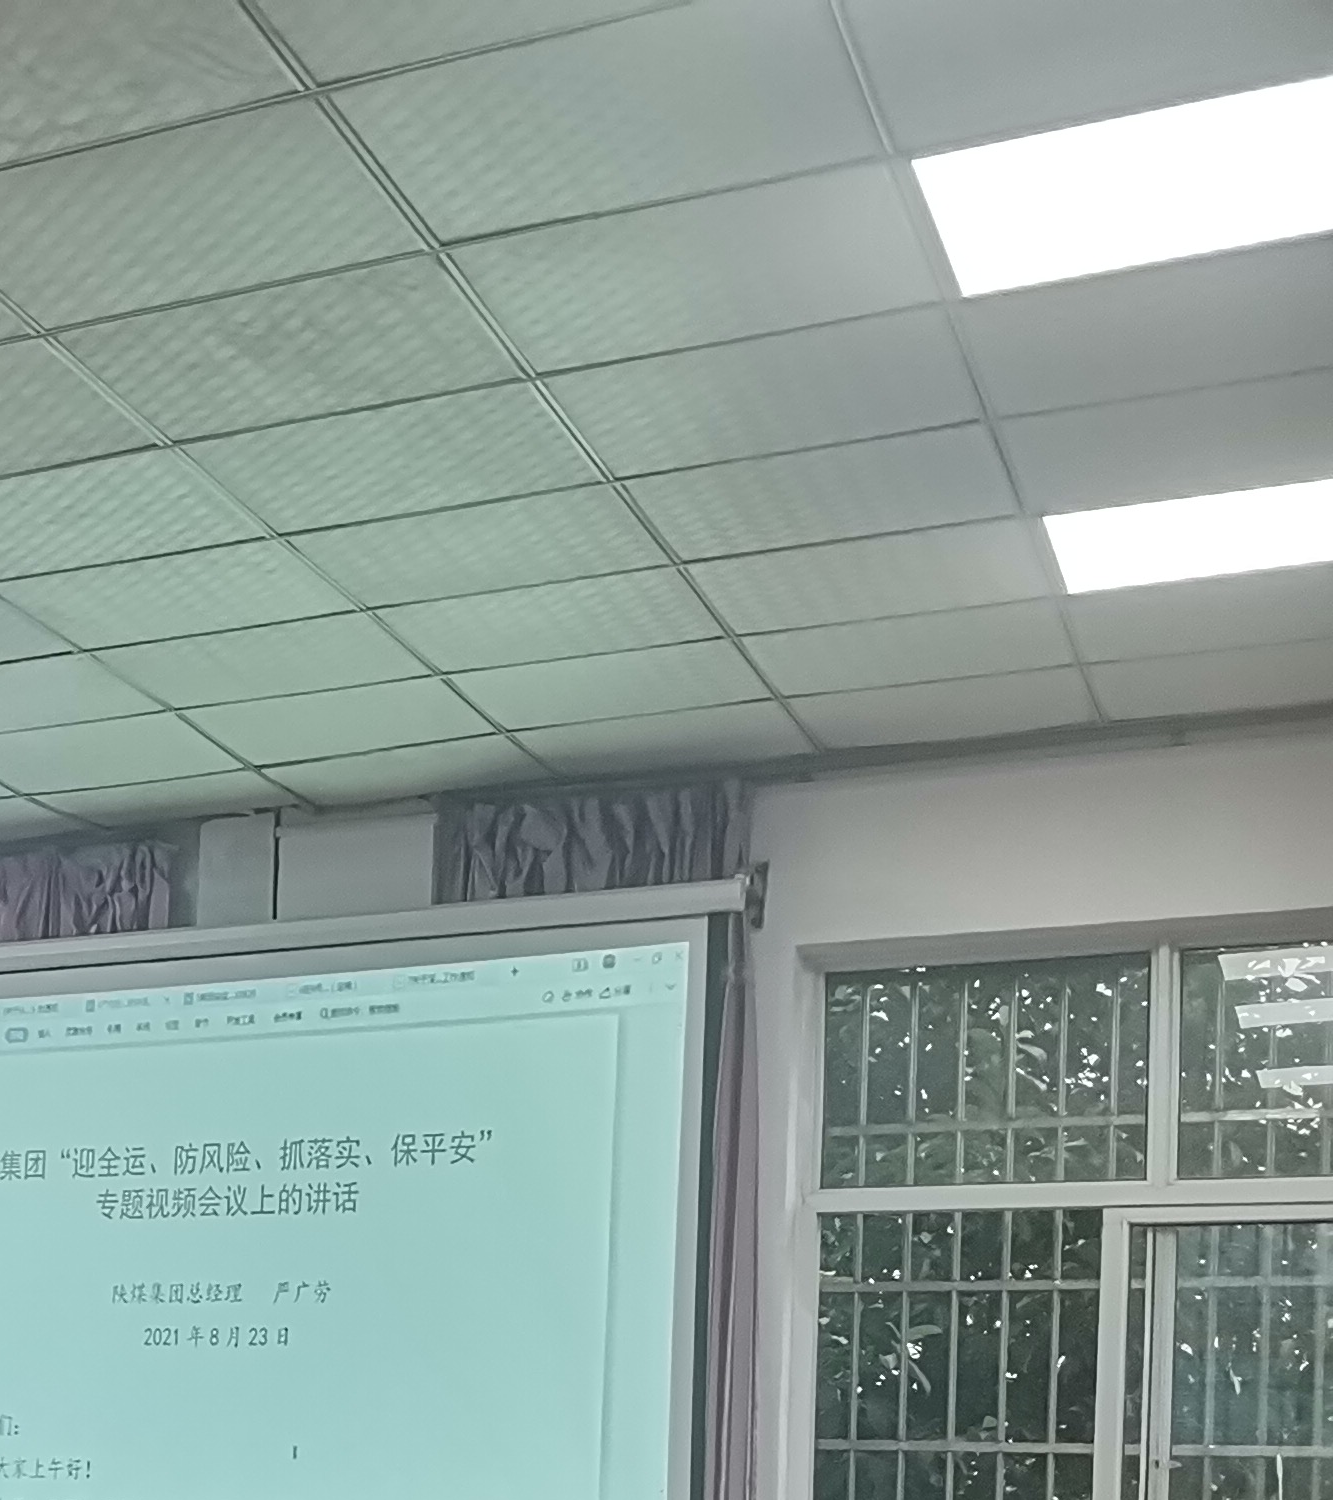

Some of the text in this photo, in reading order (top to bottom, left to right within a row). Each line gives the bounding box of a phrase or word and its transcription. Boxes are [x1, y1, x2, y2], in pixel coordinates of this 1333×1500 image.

[96, 1182, 360, 1220] 专题视频会议上的讲话
